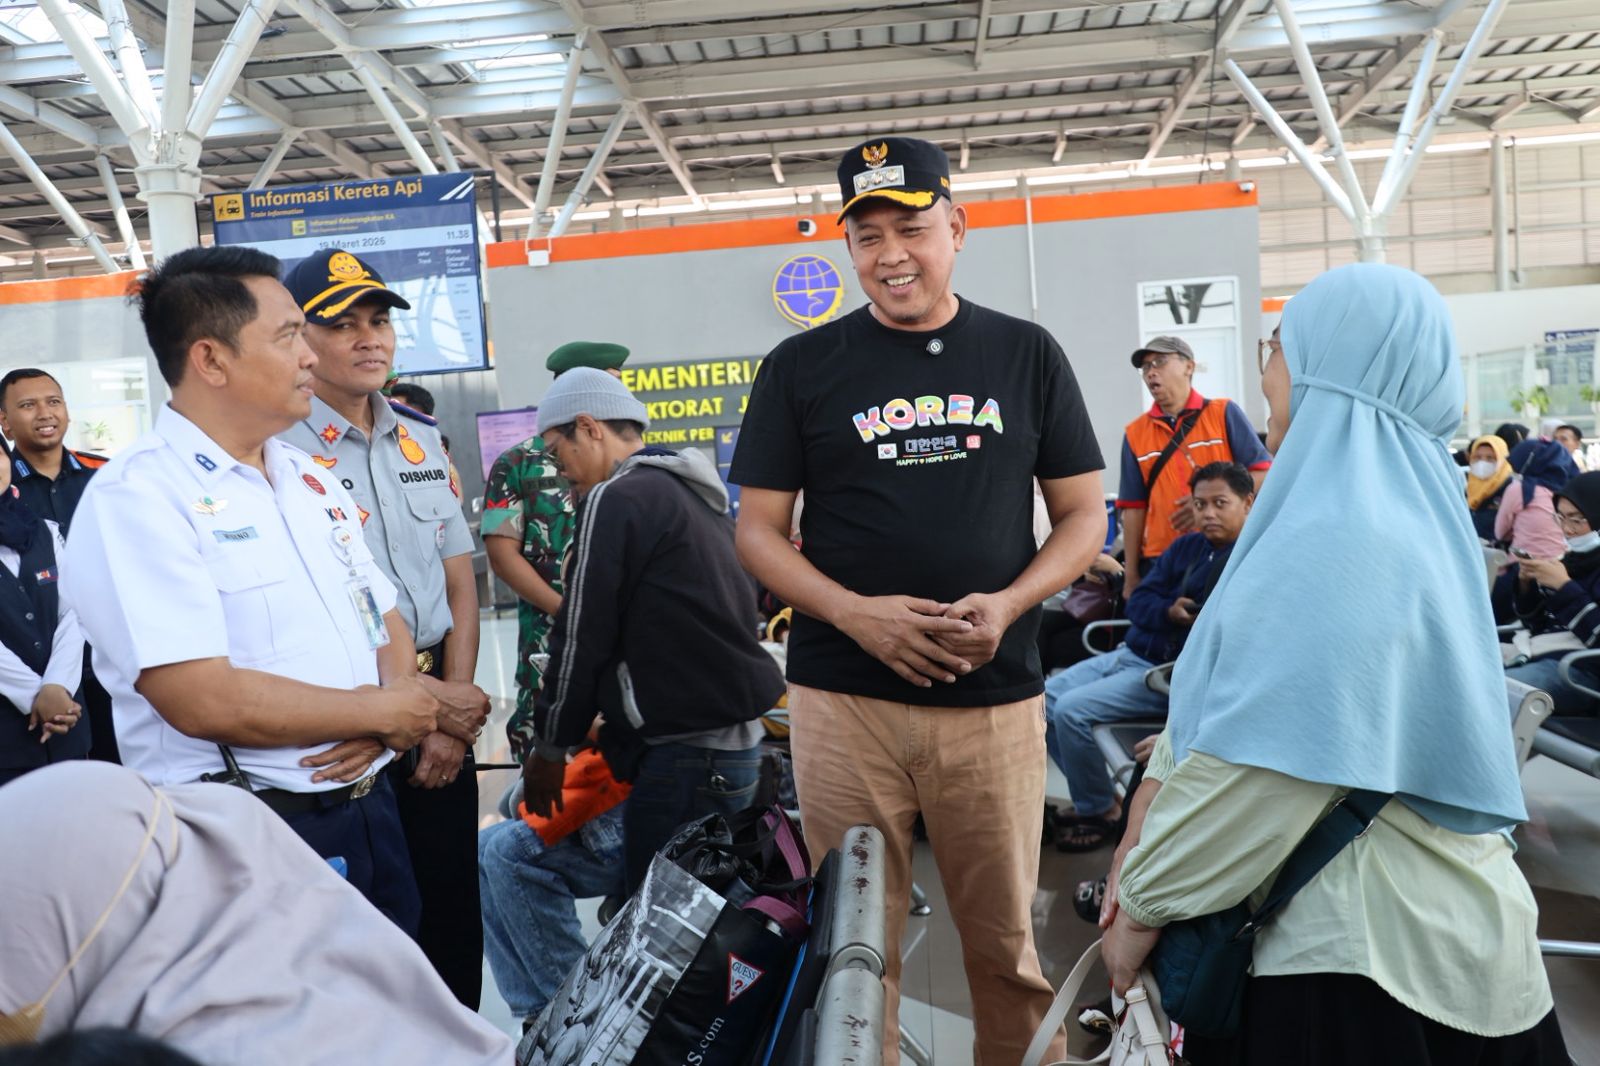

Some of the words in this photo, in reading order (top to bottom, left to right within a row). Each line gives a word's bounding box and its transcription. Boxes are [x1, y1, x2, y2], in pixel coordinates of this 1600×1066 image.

[250, 186, 330, 208] Informasi
[334, 183, 390, 201] Kereta
[394, 179, 423, 198] Api
[332, 239, 360, 250] Maret
[362, 236, 386, 247] 2026
[446, 229, 470, 240] 11.38
[620, 359, 763, 392] EMENTERI
[852, 394, 1004, 443] KOREA
[690, 427, 715, 442] PER
[904, 435, 957, 453] 대한민국
[896, 458, 918, 466] HAPPY
[925, 455, 943, 464] HOPE
[949, 452, 967, 460] LOVE
[399, 469, 446, 484] DISHUB
[732, 961, 757, 980] GUESS
[682, 1017, 725, 1066] S.com
